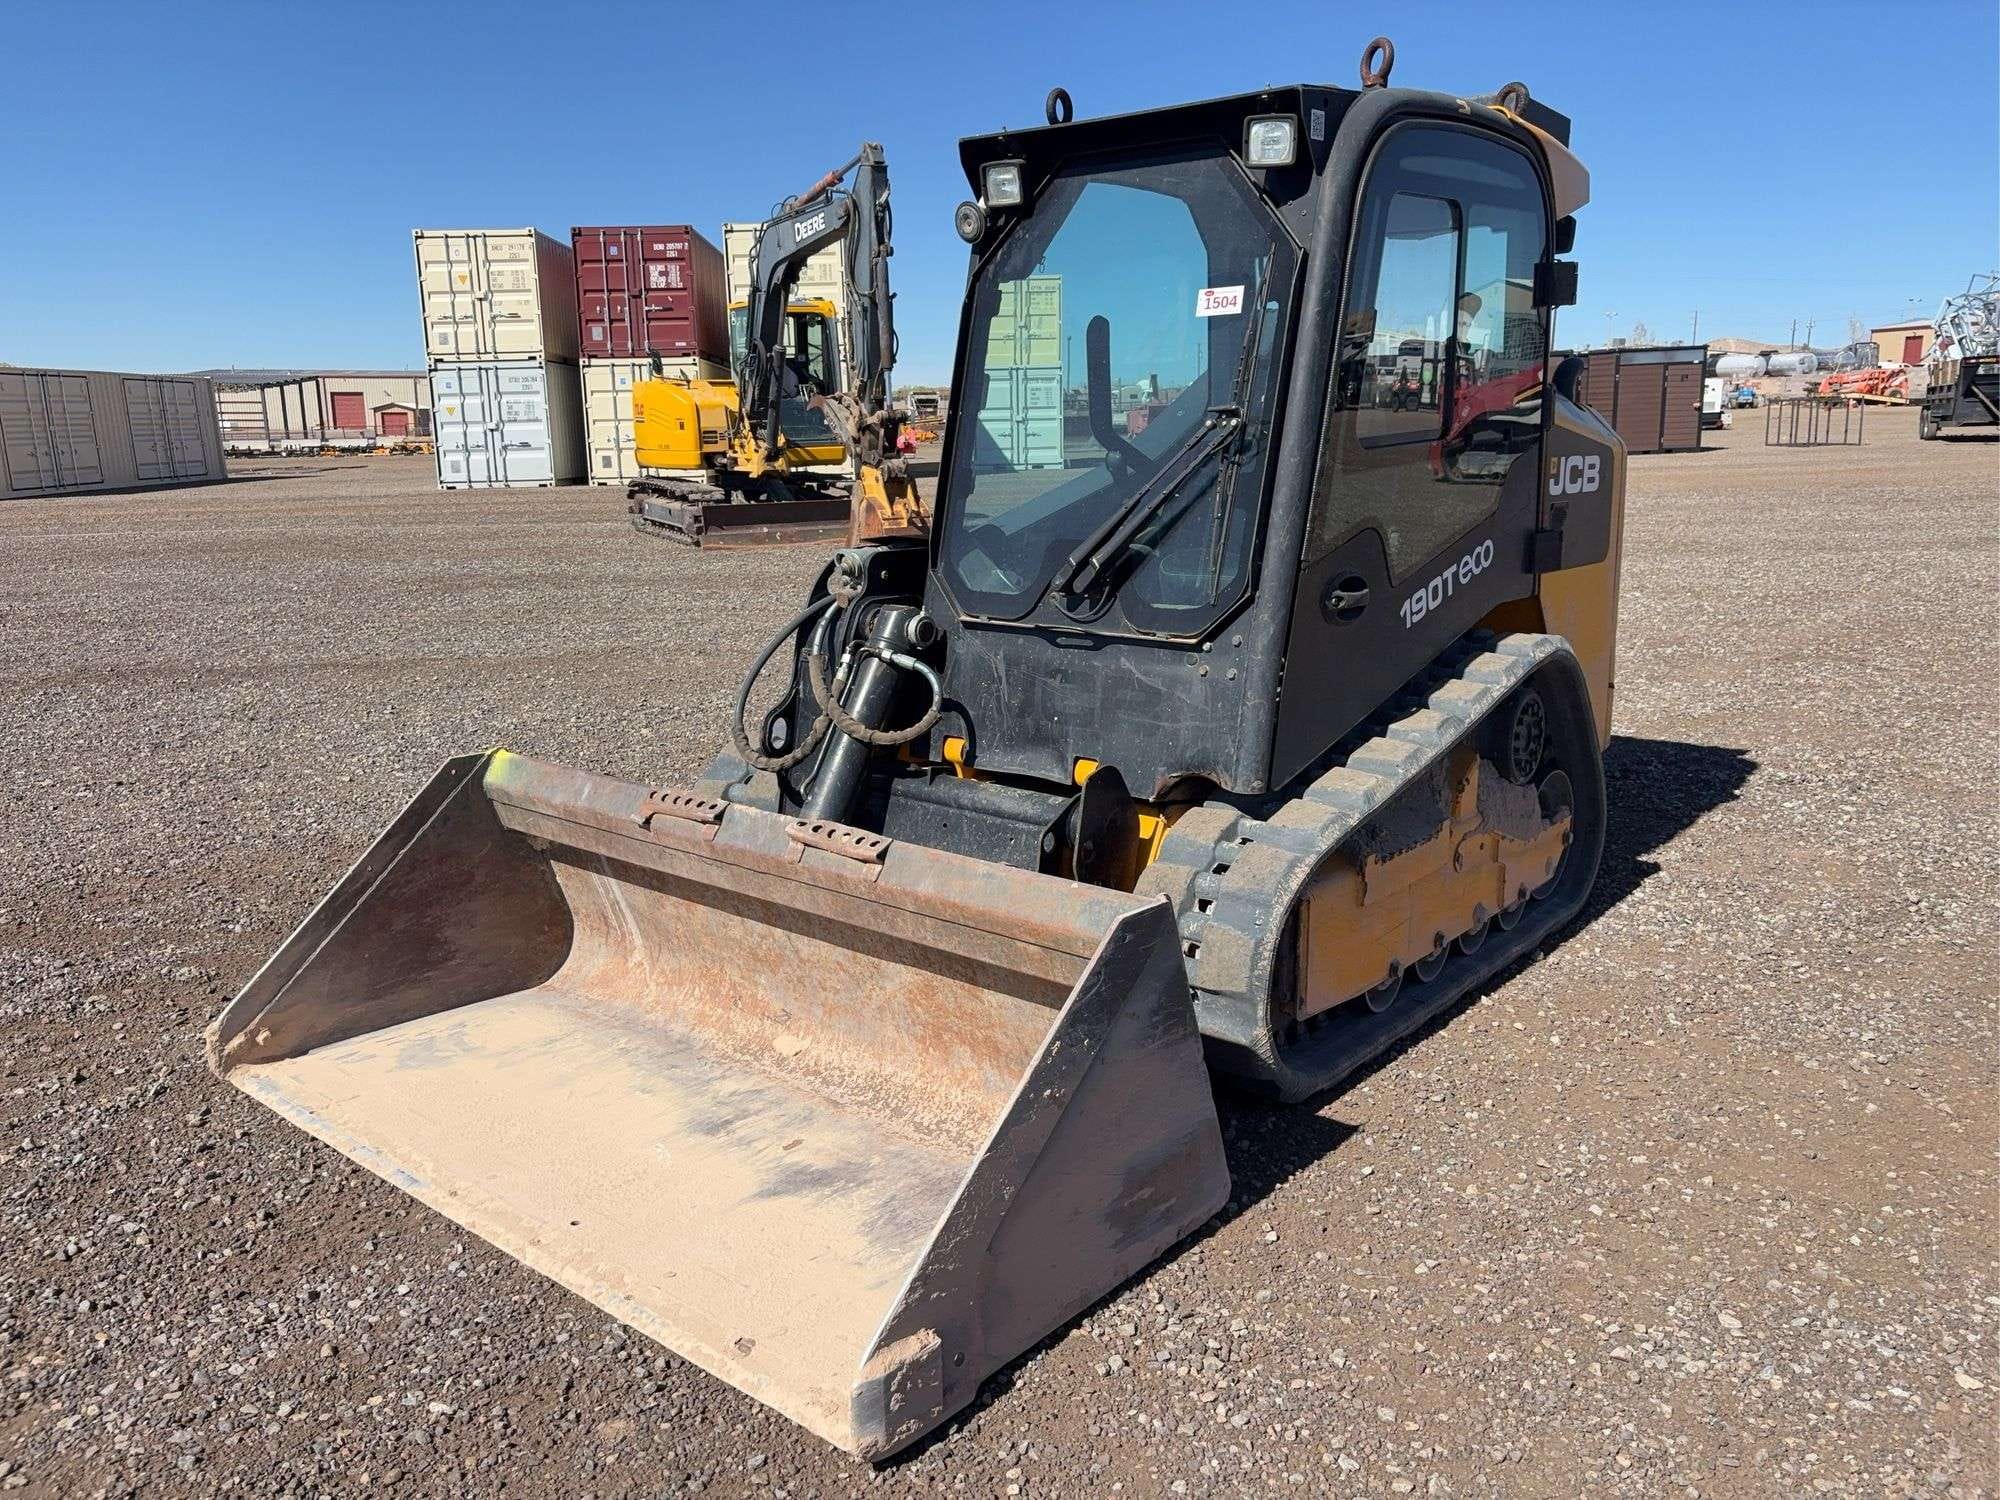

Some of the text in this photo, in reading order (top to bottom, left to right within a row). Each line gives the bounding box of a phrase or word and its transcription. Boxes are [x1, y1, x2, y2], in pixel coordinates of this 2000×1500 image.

[794, 212, 826, 242] DEERE
[1204, 296, 1238, 310] 1504
[1549, 455, 1601, 495] JCB
